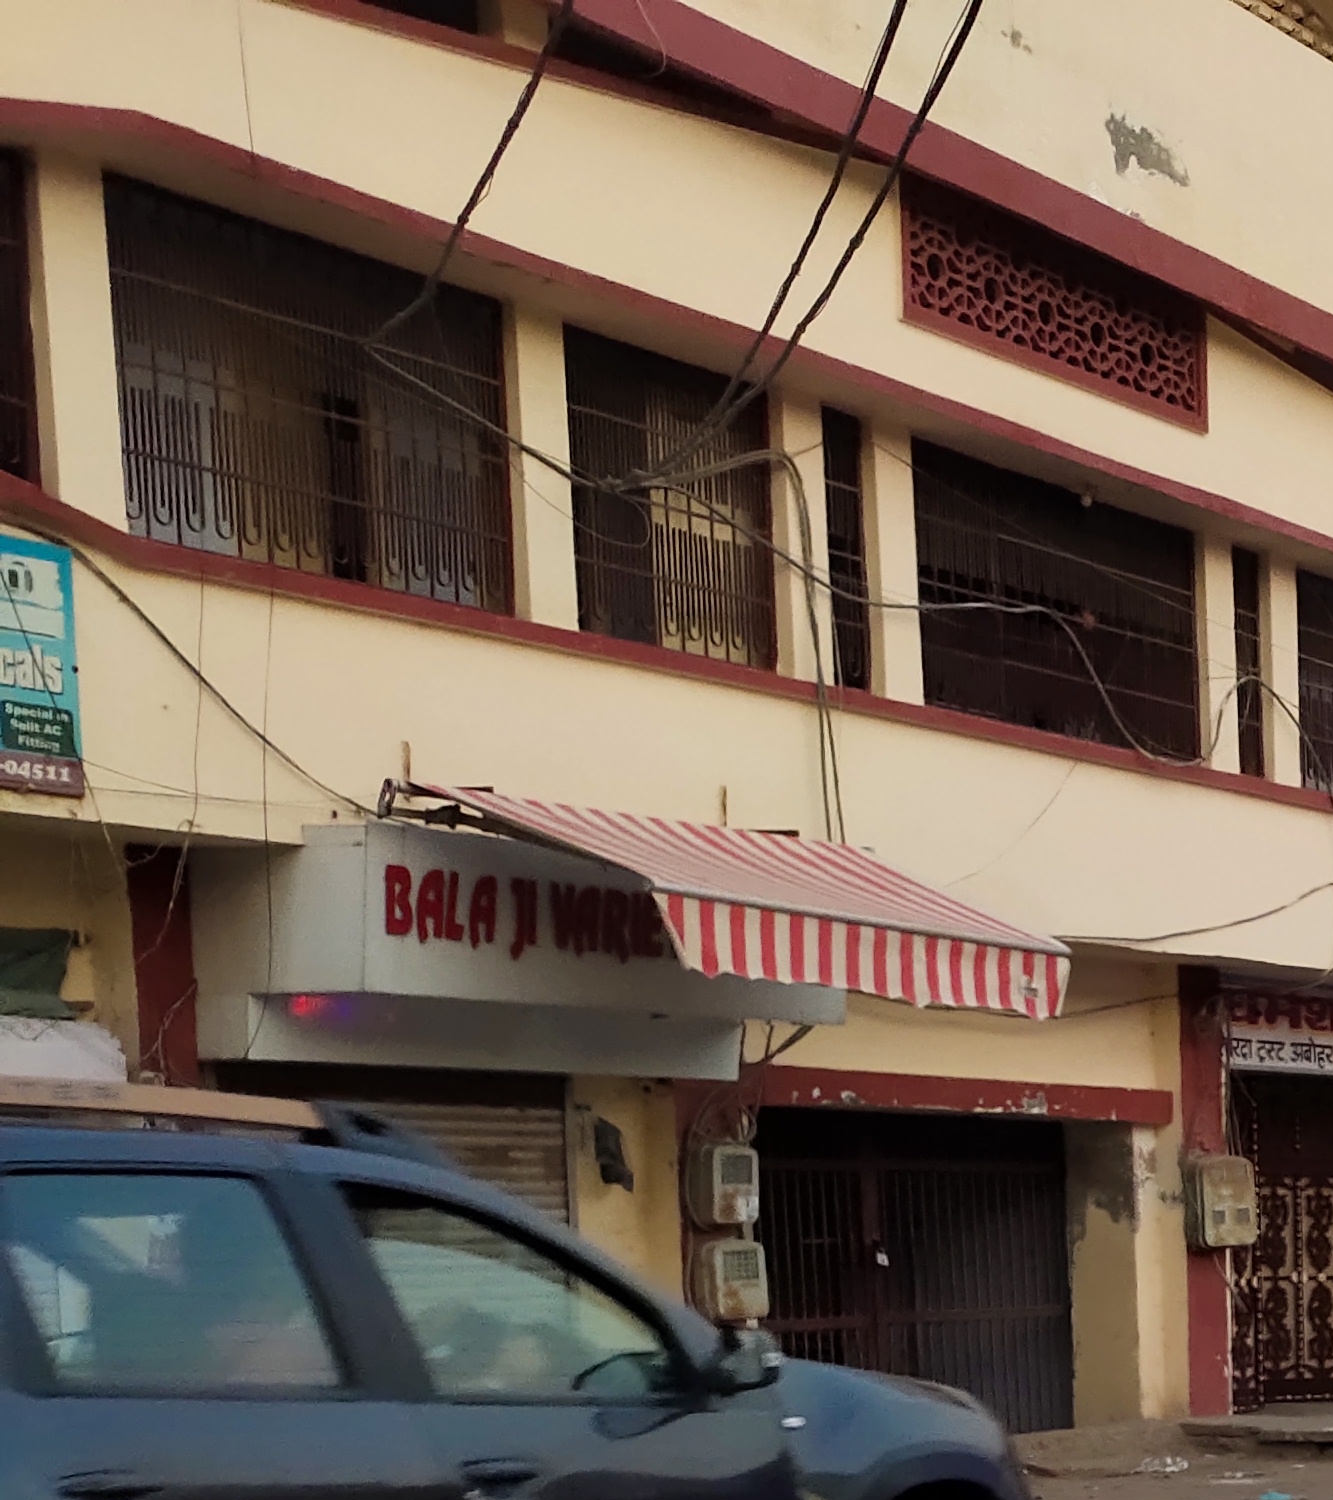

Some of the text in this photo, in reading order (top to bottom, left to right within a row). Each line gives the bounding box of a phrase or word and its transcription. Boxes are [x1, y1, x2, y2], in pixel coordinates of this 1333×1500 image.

[5, 702, 53, 721] Special
[43, 723, 63, 736] AC
[385, 864, 498, 949] BALA
[550, 881, 679, 964] VARIE
